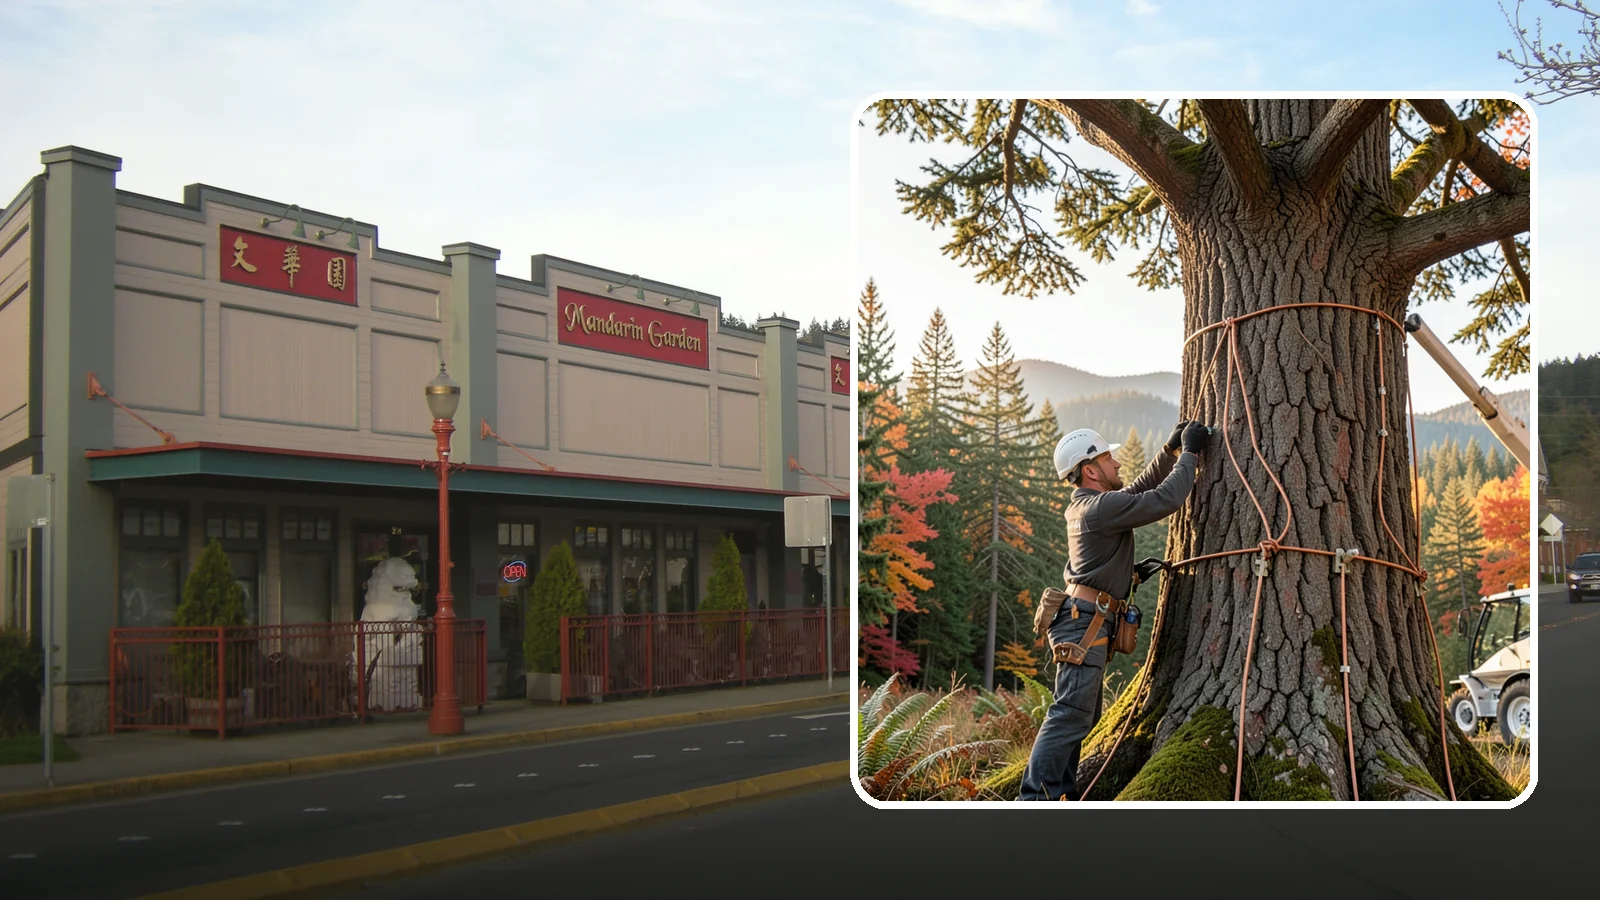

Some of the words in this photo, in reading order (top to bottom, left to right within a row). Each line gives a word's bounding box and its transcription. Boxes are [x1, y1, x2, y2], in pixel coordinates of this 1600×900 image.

[230, 235, 346, 291] 文華園
[564, 302, 644, 341] Mandarin
[647, 320, 702, 352] Garden
[503, 565, 527, 578] OPEN
